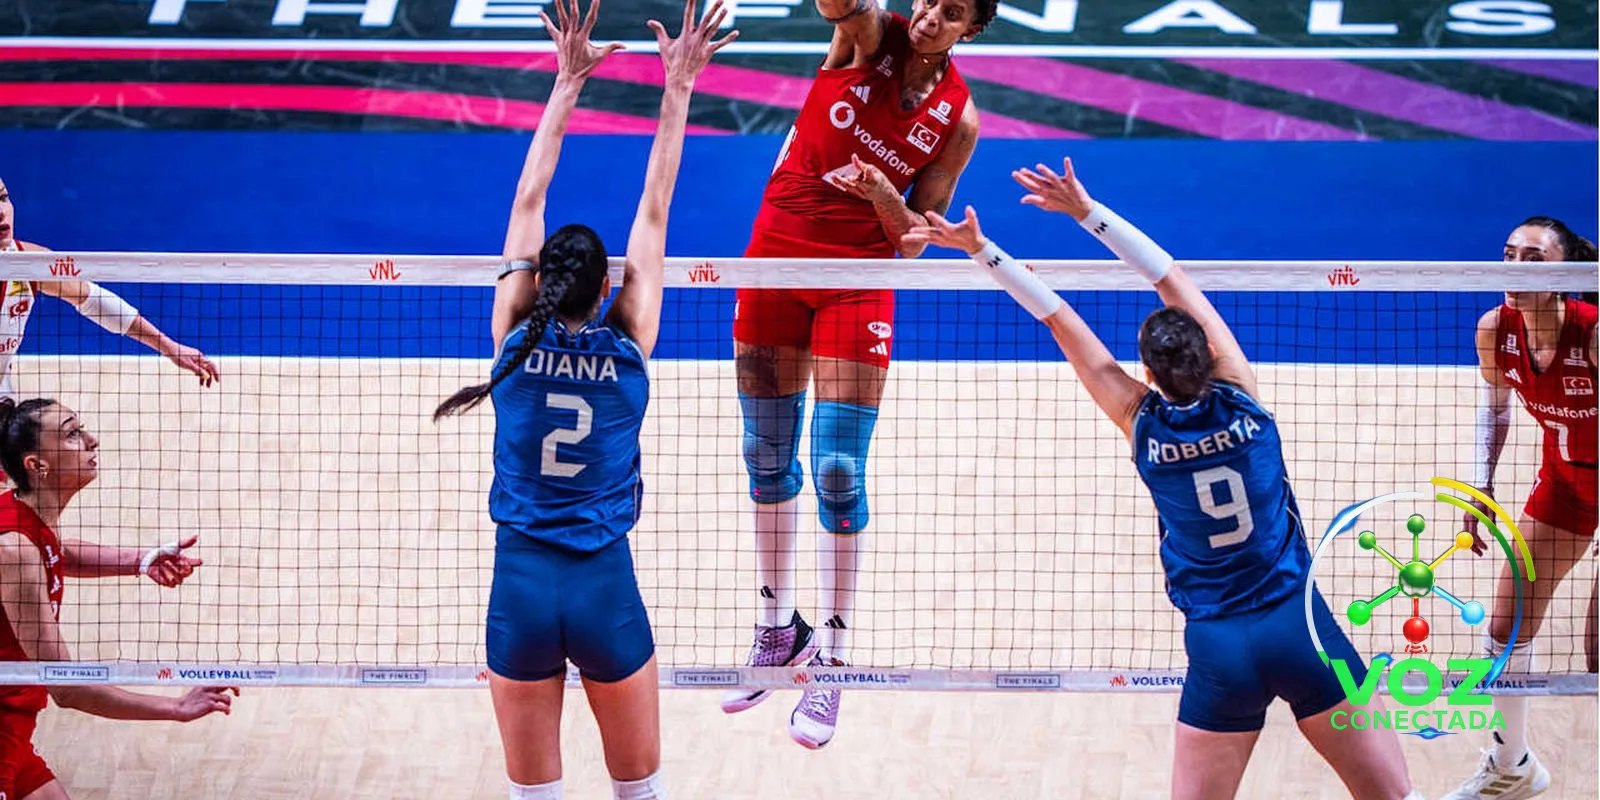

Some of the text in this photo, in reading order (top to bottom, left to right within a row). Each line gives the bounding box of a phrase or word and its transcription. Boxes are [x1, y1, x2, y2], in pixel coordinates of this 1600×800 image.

[700, 0, 1556, 36] FNALS
[854, 124, 916, 176] vodafone
[524, 348, 619, 382] DIANA
[1529, 400, 1598, 419] vodafone
[540, 392, 593, 477] 2
[1147, 415, 1261, 464] ROBERTA
[1192, 465, 1254, 549] 9
[179, 669, 252, 680] VOLLEYBALL
[814, 673, 888, 684] VOLLEYBALL
[1132, 676, 1184, 687] VOLLEYB
